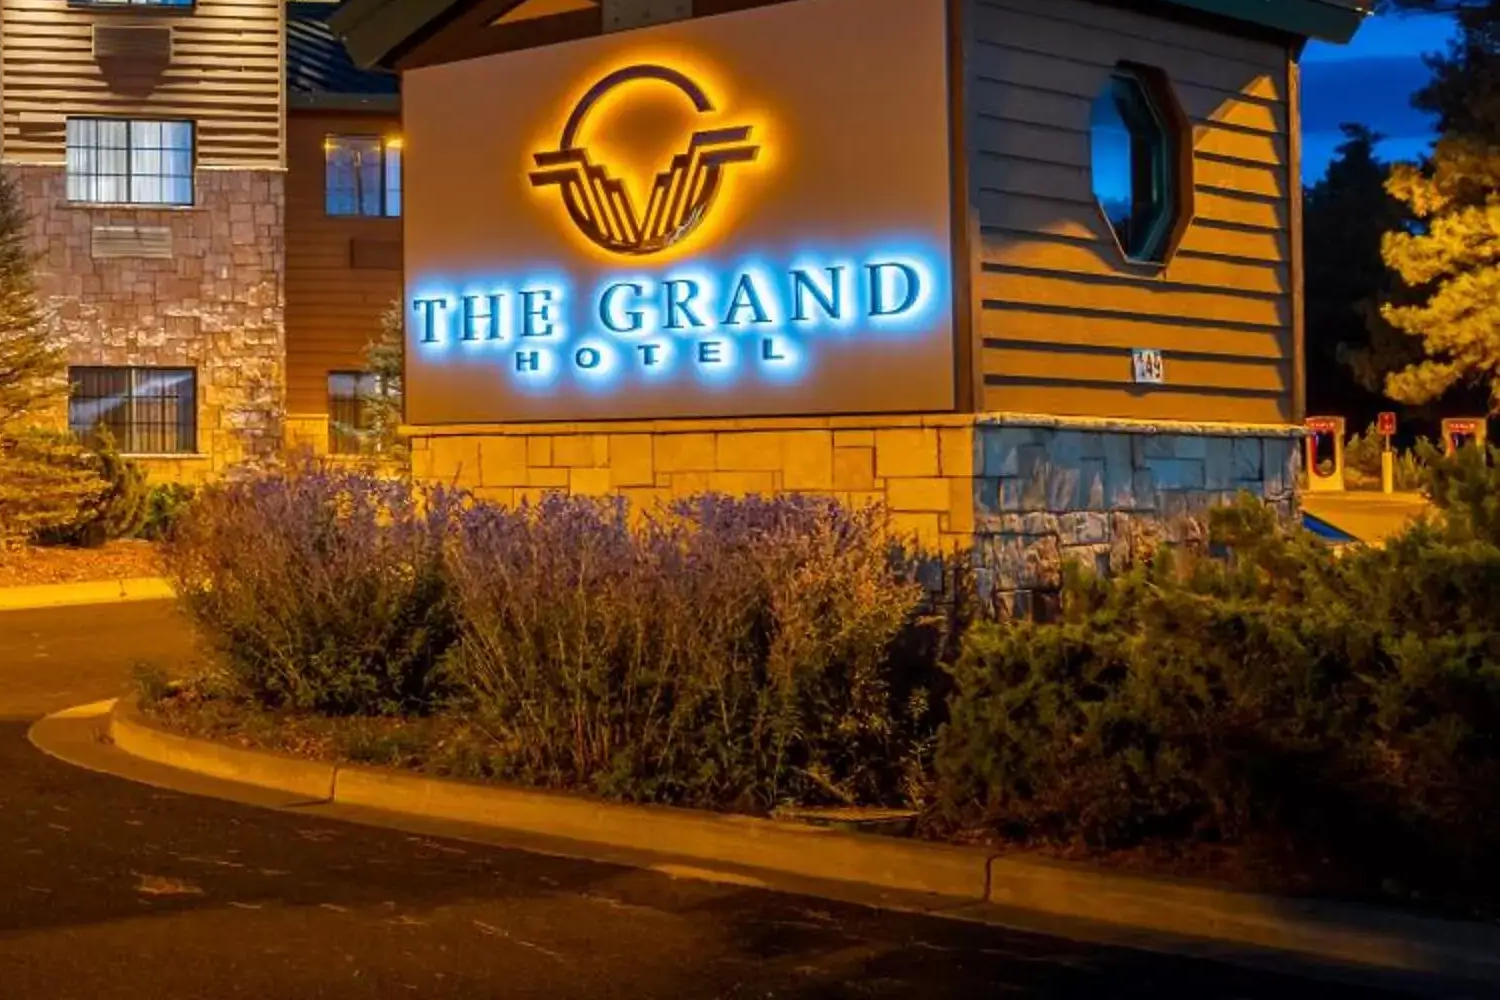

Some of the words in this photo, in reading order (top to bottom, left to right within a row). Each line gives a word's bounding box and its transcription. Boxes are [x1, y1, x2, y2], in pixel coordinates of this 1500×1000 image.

[413, 289, 554, 343] THE
[600, 262, 921, 332] GRAND
[514, 337, 785, 371] HOTEL
